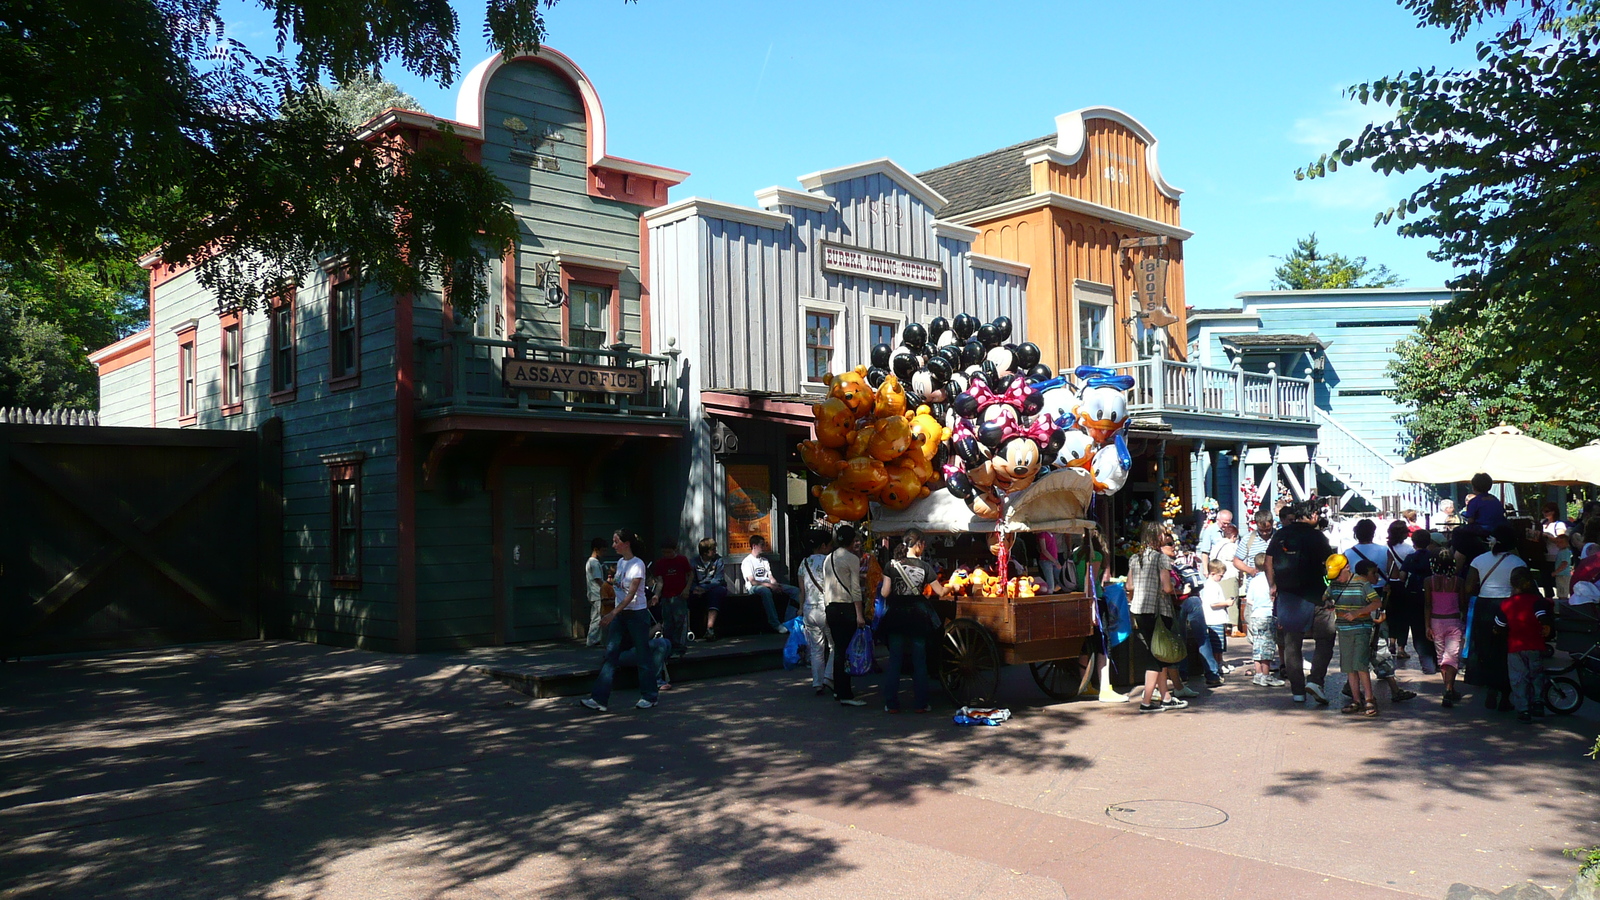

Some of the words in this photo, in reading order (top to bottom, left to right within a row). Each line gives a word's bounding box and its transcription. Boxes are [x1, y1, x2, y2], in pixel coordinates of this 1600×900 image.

[827, 249, 862, 269] EUREKA
[866, 255, 897, 275] MINING
[901, 262, 937, 283] SUPPLIES
[1145, 263, 1156, 311] BOOTS
[514, 365, 574, 385] ASSAY
[578, 370, 637, 388] OFFICE
